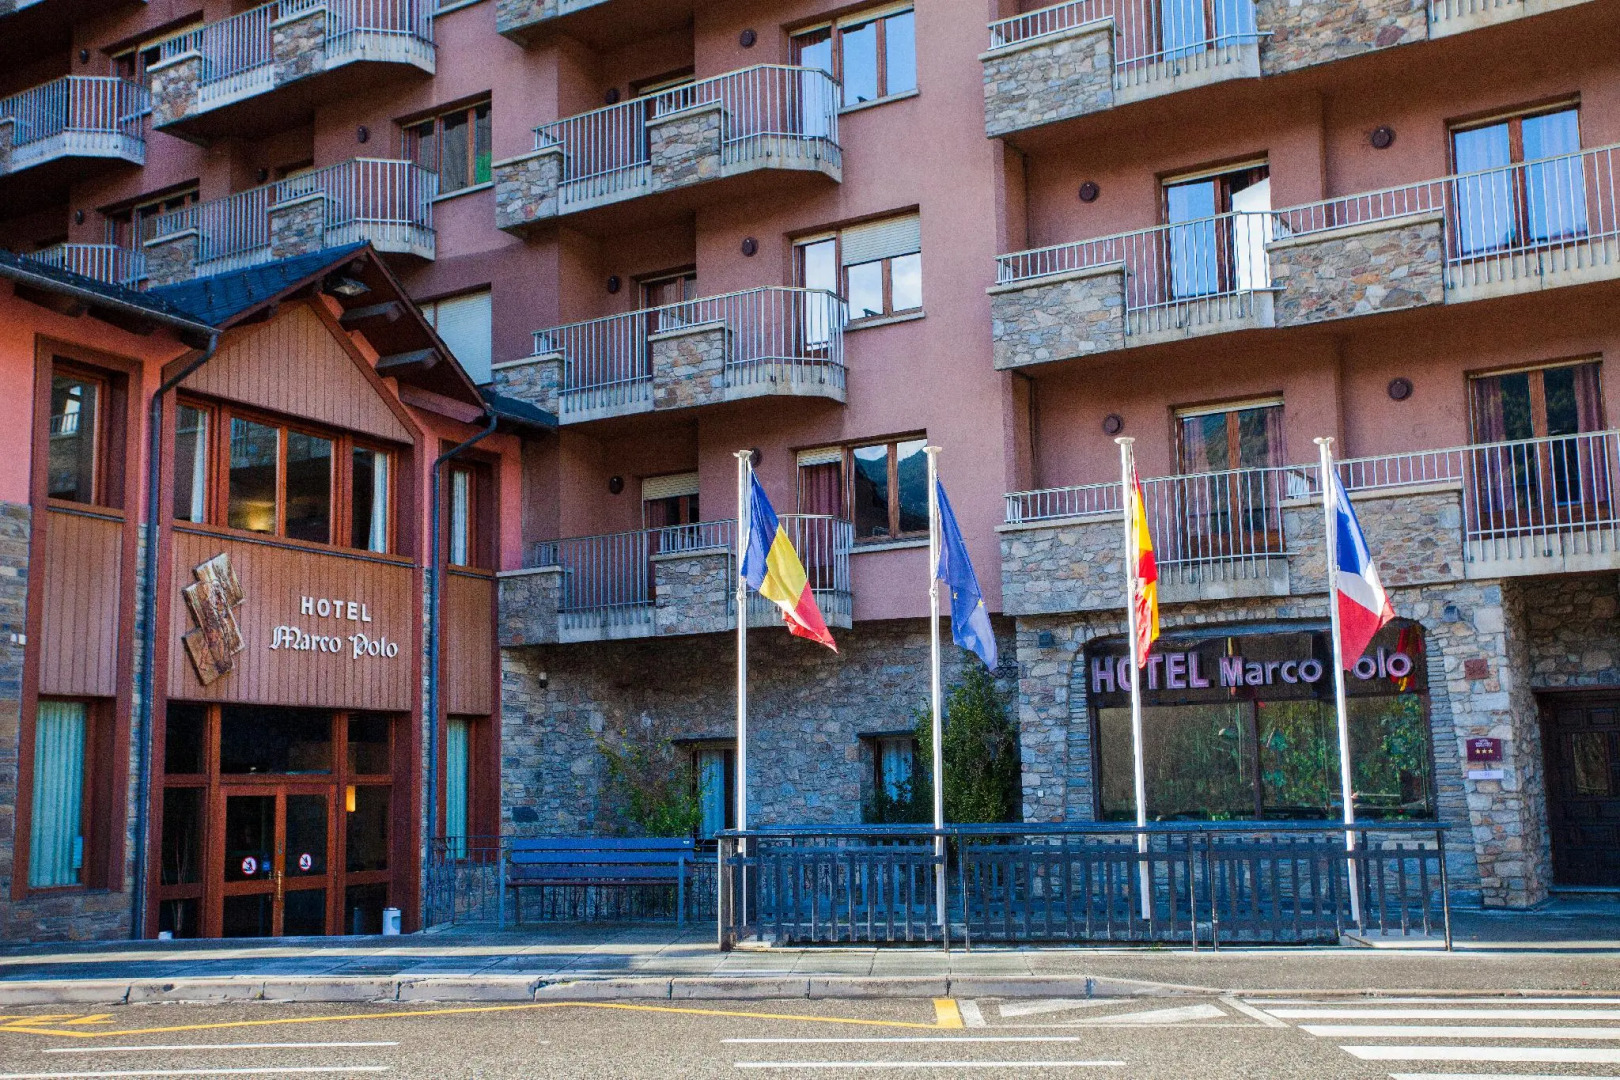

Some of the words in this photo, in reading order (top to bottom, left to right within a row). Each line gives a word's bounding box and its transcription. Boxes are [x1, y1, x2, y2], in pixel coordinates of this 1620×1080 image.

[301, 596, 372, 622] HOTEL
[269, 625, 342, 653] Marco
[348, 633, 398, 660] Polo
[1219, 655, 1322, 687] Marco
[1336, 646, 1412, 680] olo
